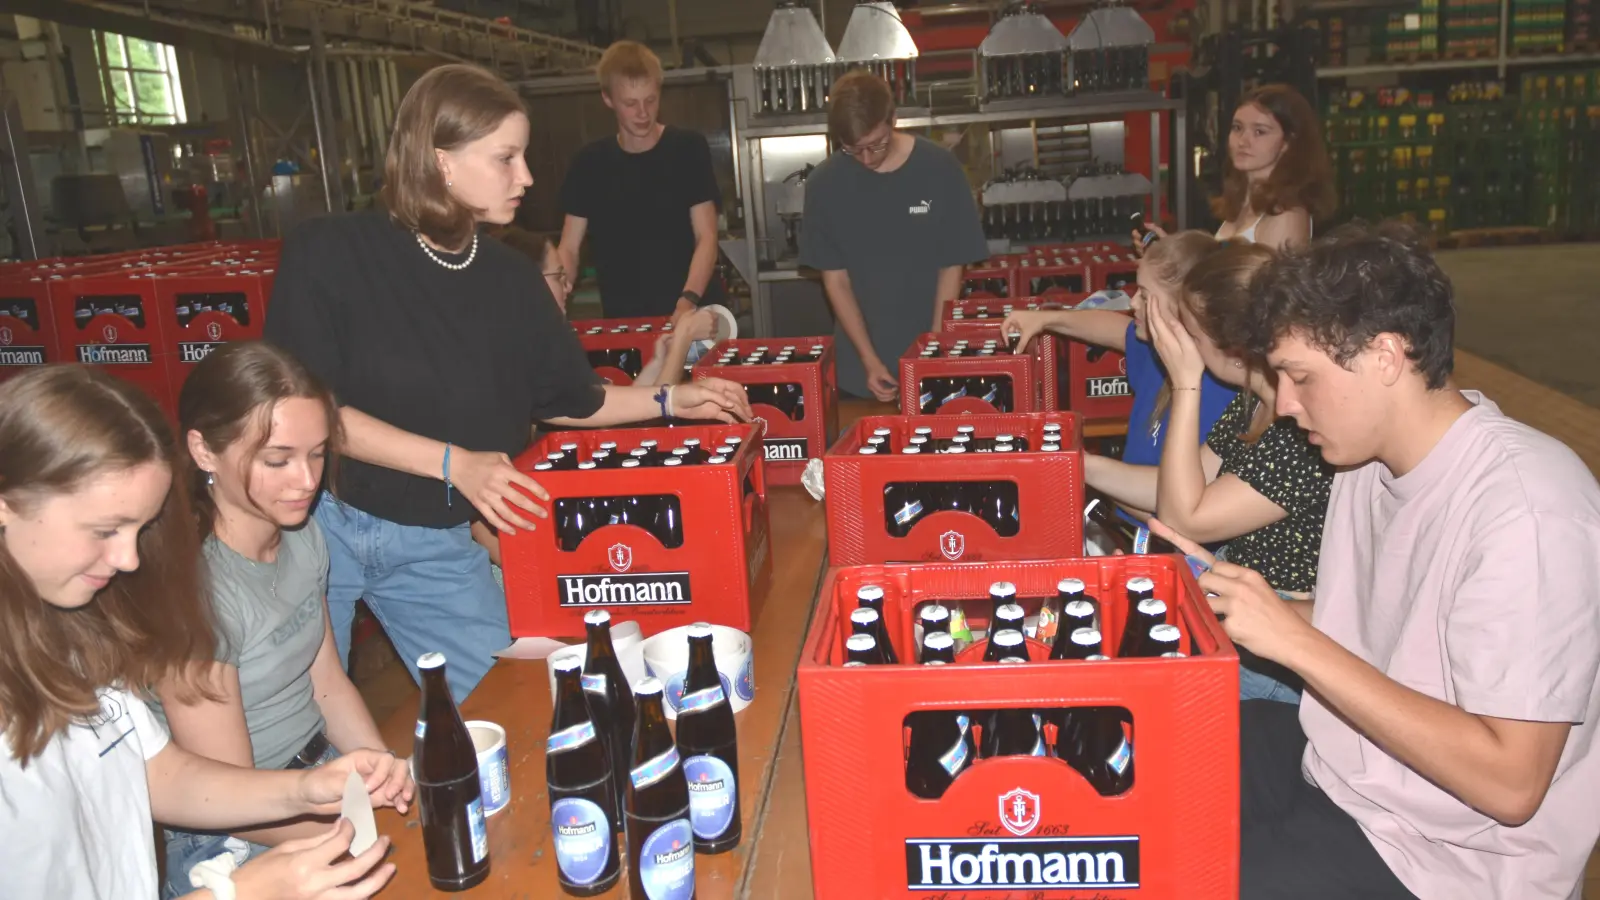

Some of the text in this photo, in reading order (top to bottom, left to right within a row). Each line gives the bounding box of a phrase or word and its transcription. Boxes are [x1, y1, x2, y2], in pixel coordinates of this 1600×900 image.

[80, 346, 148, 364] Hofmann
[183, 344, 216, 361] Hof
[763, 444, 803, 459] ann
[565, 577, 684, 604] Hofmann
[688, 780, 723, 792] Hofmann
[558, 824, 595, 836] Hofmann
[967, 821, 1070, 836] Seit 1663
[919, 843, 1126, 885] Hofmann
